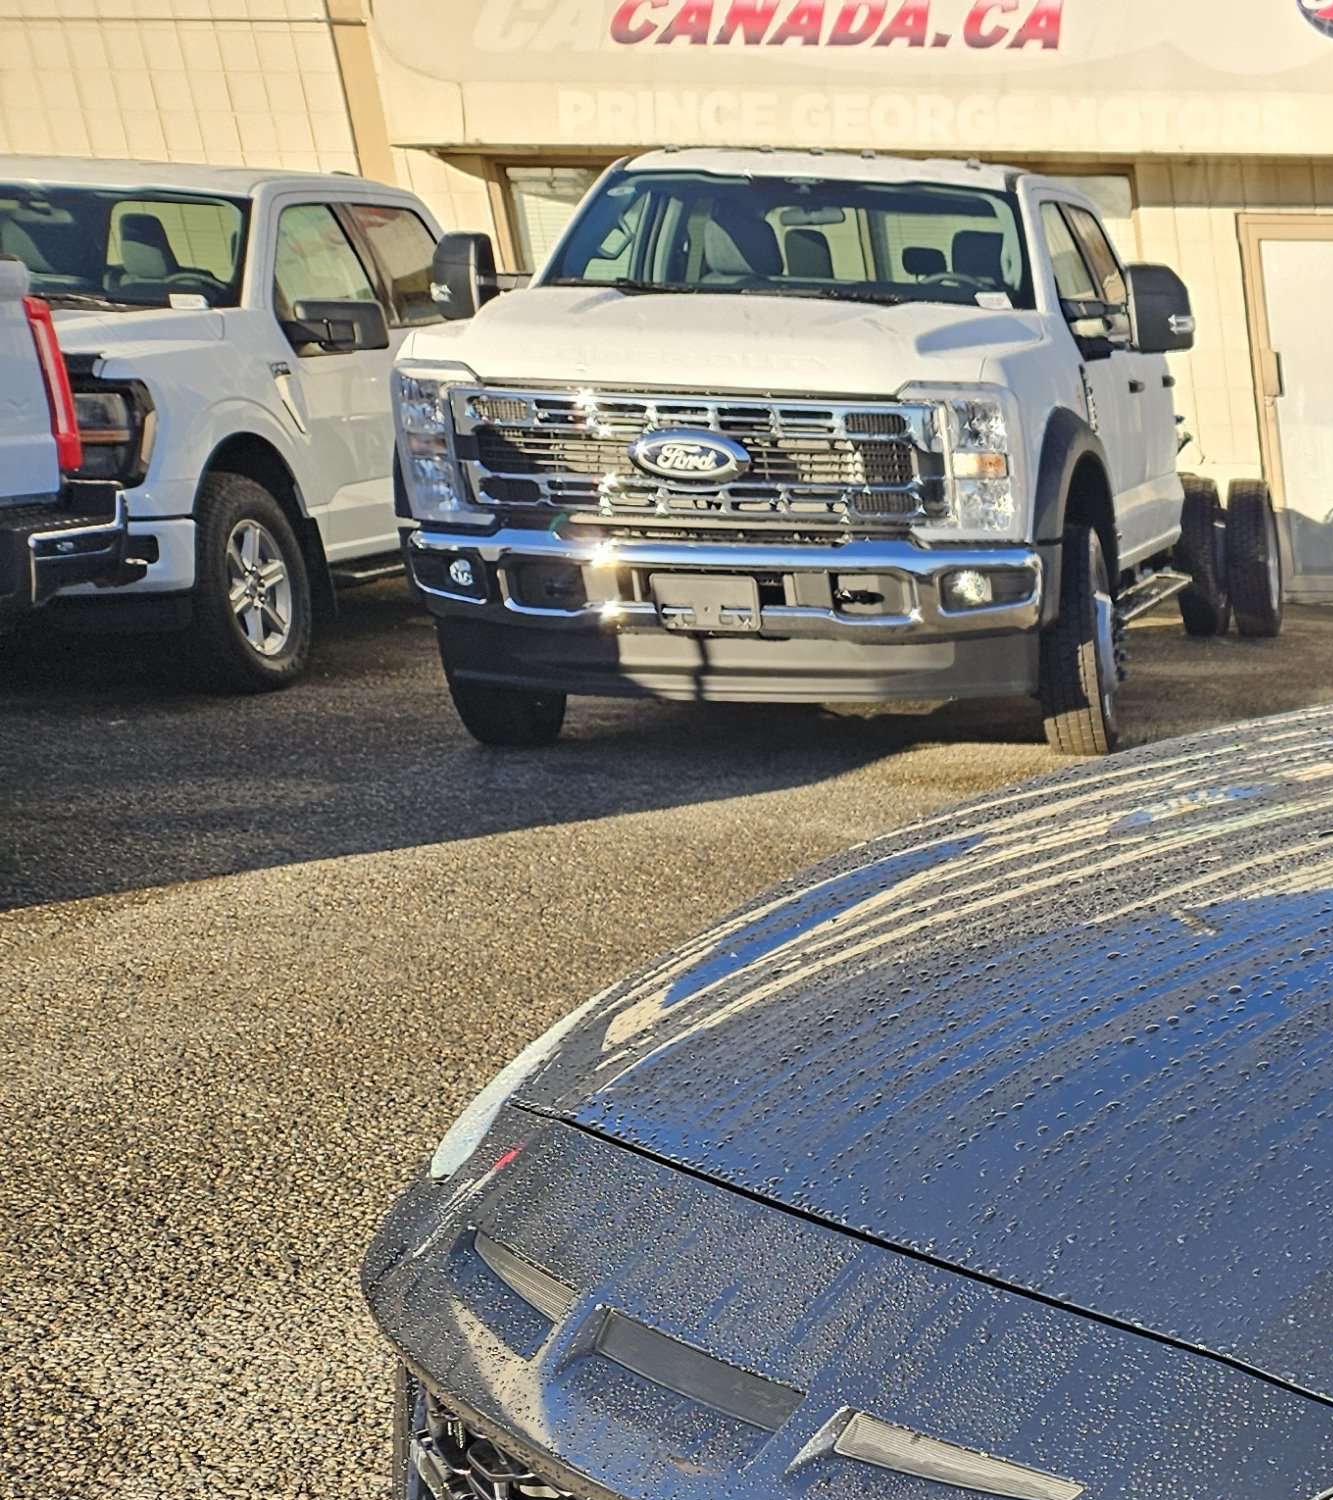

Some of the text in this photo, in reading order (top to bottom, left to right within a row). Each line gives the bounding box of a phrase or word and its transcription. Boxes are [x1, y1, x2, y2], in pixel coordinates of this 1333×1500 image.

[608, 0, 1062, 50] CANADA.CA
[558, 91, 778, 139] PRINCE
[657, 443, 718, 471] Ford
